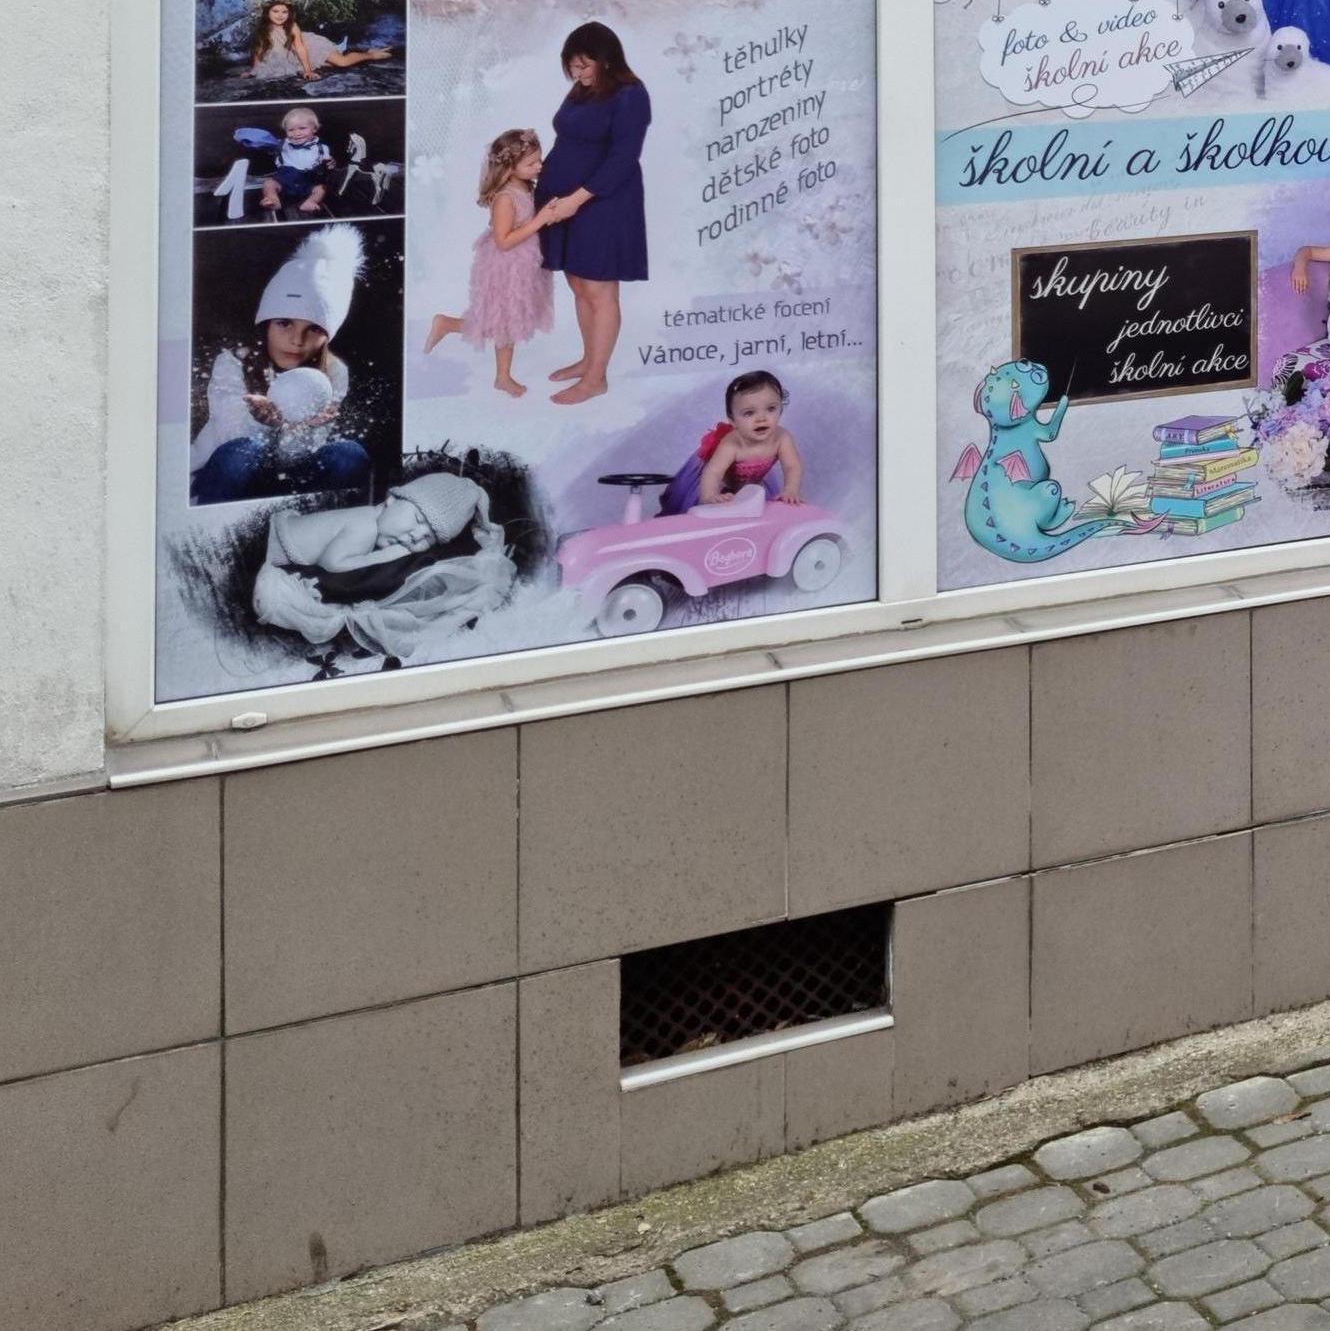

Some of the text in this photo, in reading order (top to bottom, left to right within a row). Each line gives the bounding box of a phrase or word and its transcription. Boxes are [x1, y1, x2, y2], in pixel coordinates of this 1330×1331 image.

[723, 24, 808, 74] těhulky
[1000, 4, 1158, 67] foto & video
[1023, 30, 1183, 93] školní akce
[719, 59, 814, 127] portréty
[706, 90, 827, 162] narozeniny
[702, 126, 831, 204] dětské foto
[958, 128, 1114, 188] školní
[1126, 144, 1164, 178] a
[696, 159, 837, 248] rodinné foto
[663, 298, 831, 328] tématické focení
[1028, 255, 1171, 312] skupiny
[638, 343, 726, 366] Vánoce,
[729, 334, 793, 366] jarní,
[1105, 302, 1245, 355] jednotlivci
[1108, 343, 1250, 384] školní akce
